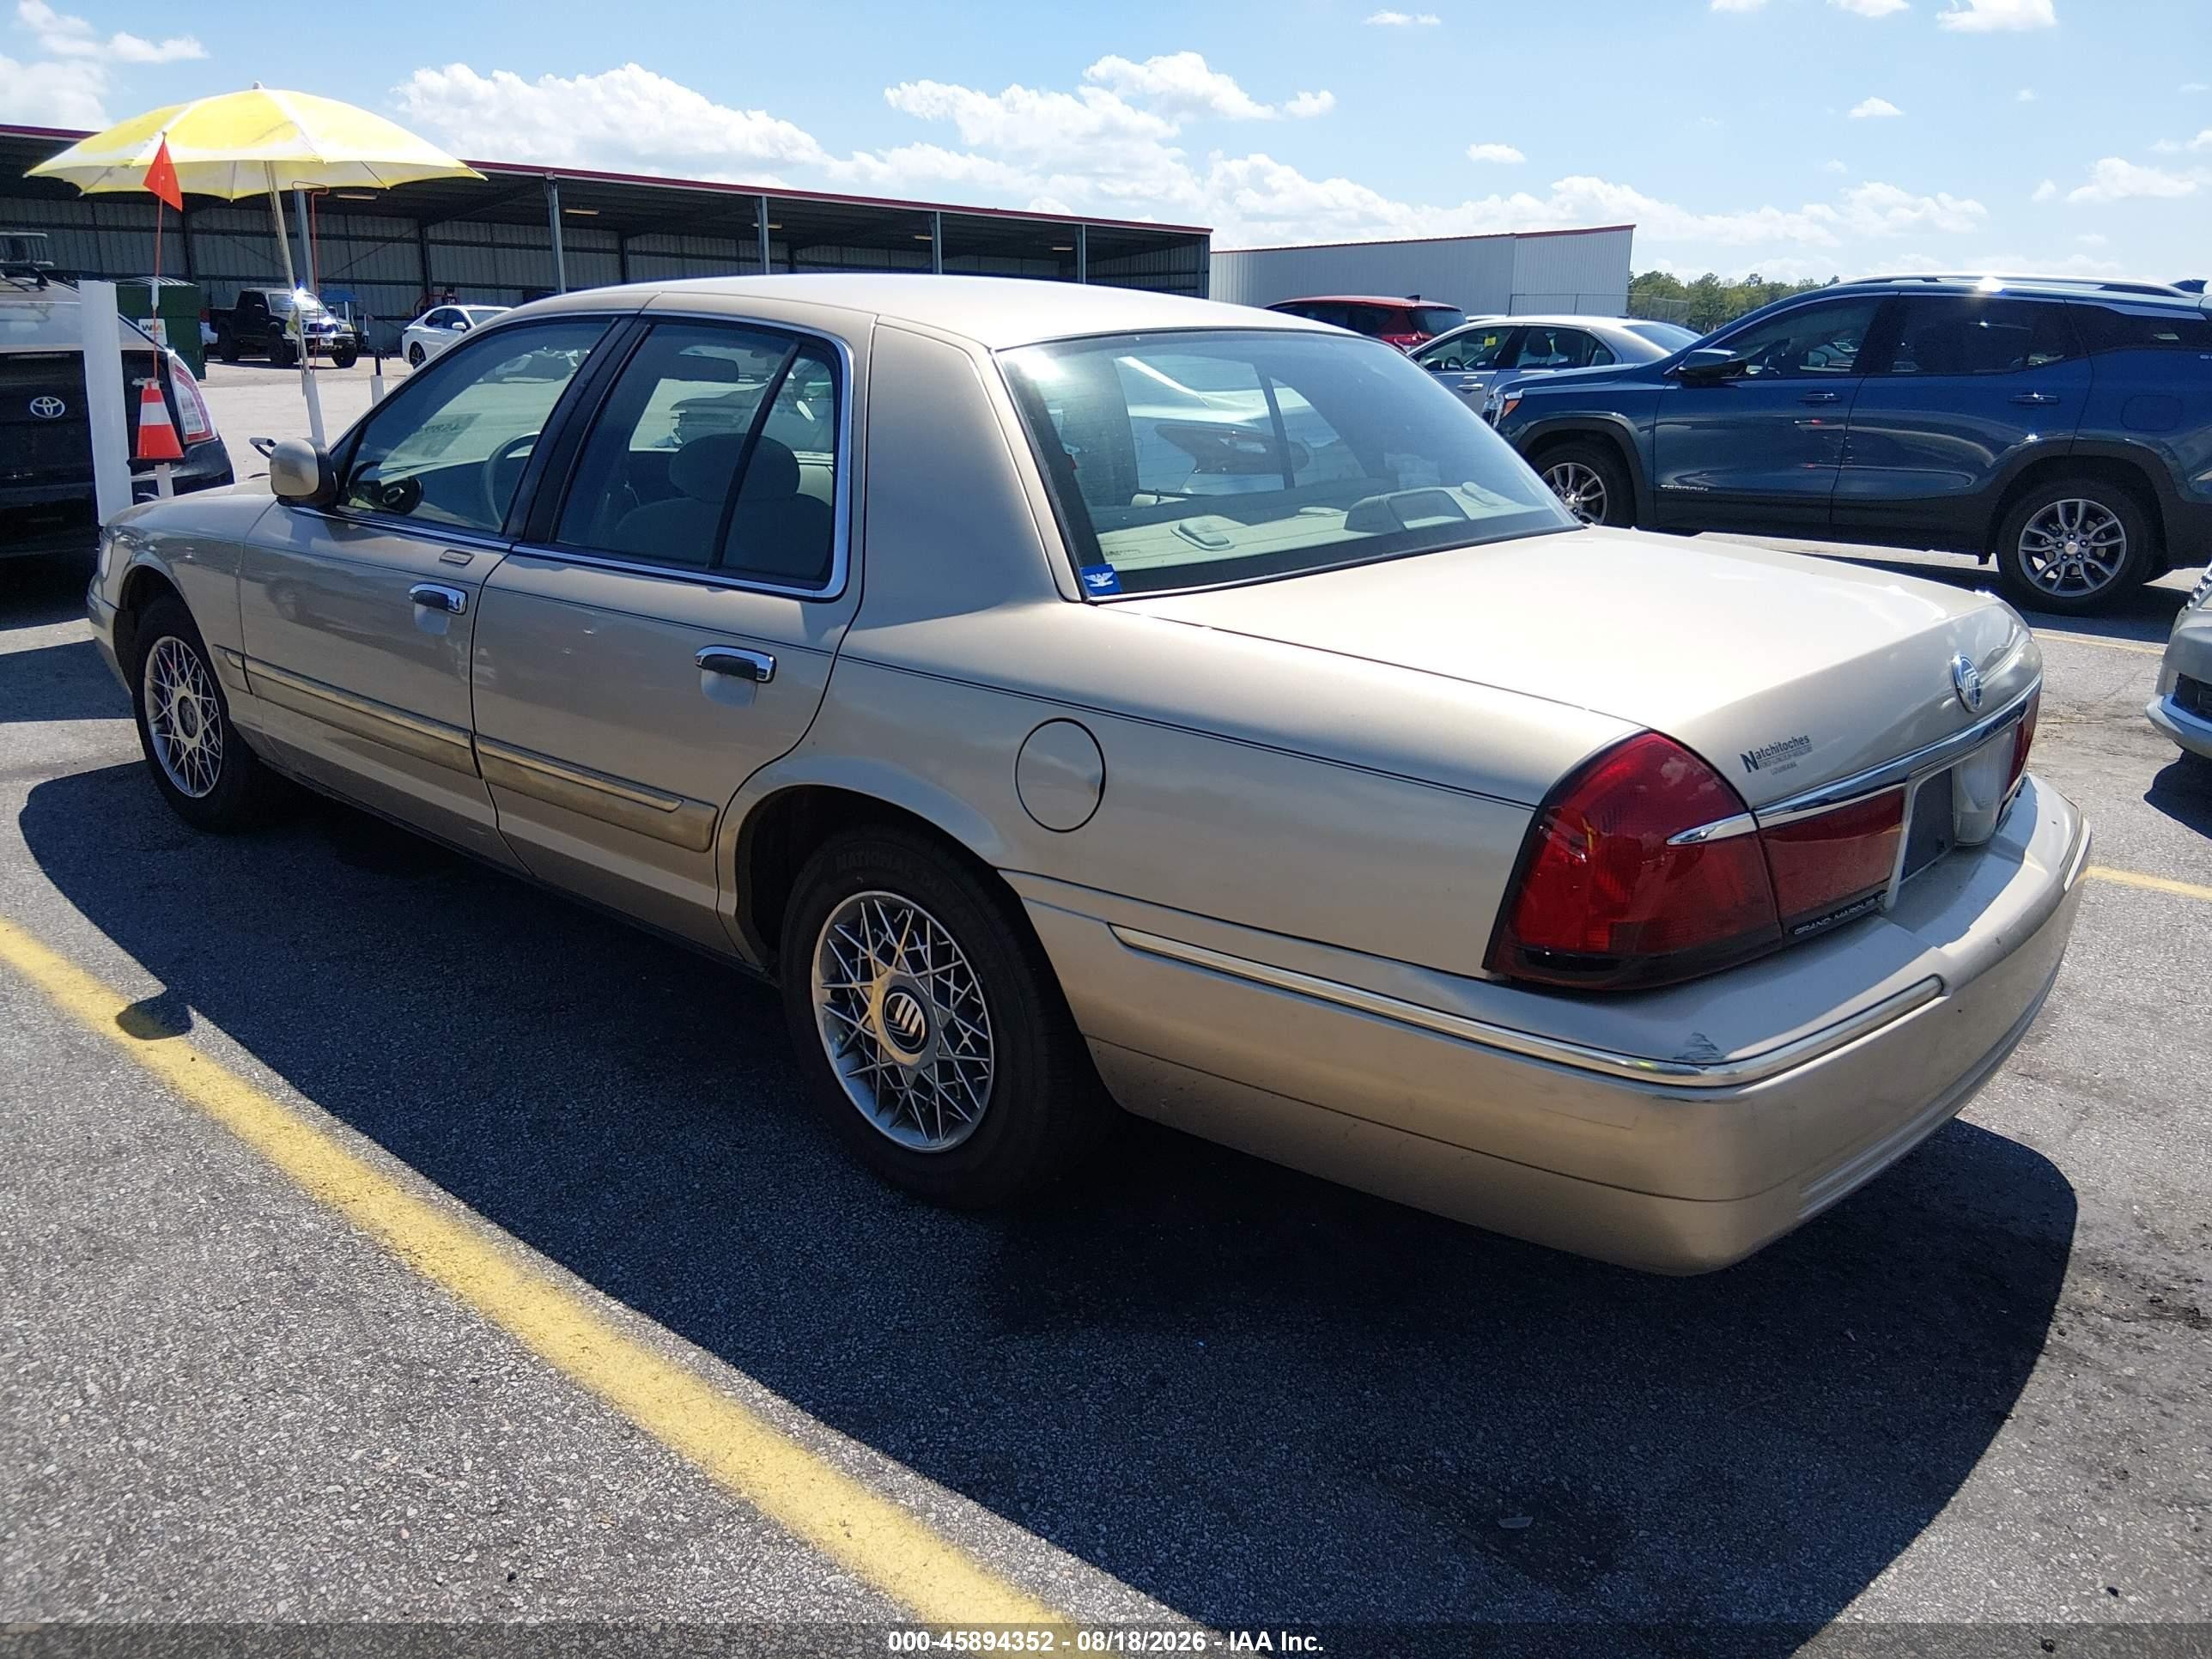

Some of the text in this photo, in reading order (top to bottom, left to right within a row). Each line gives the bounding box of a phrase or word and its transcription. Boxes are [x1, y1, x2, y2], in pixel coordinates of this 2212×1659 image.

[1740, 735, 1809, 774] Natchitoches
[1794, 916, 1831, 935] GRAND
[1834, 898, 1875, 921] MARQUIS
